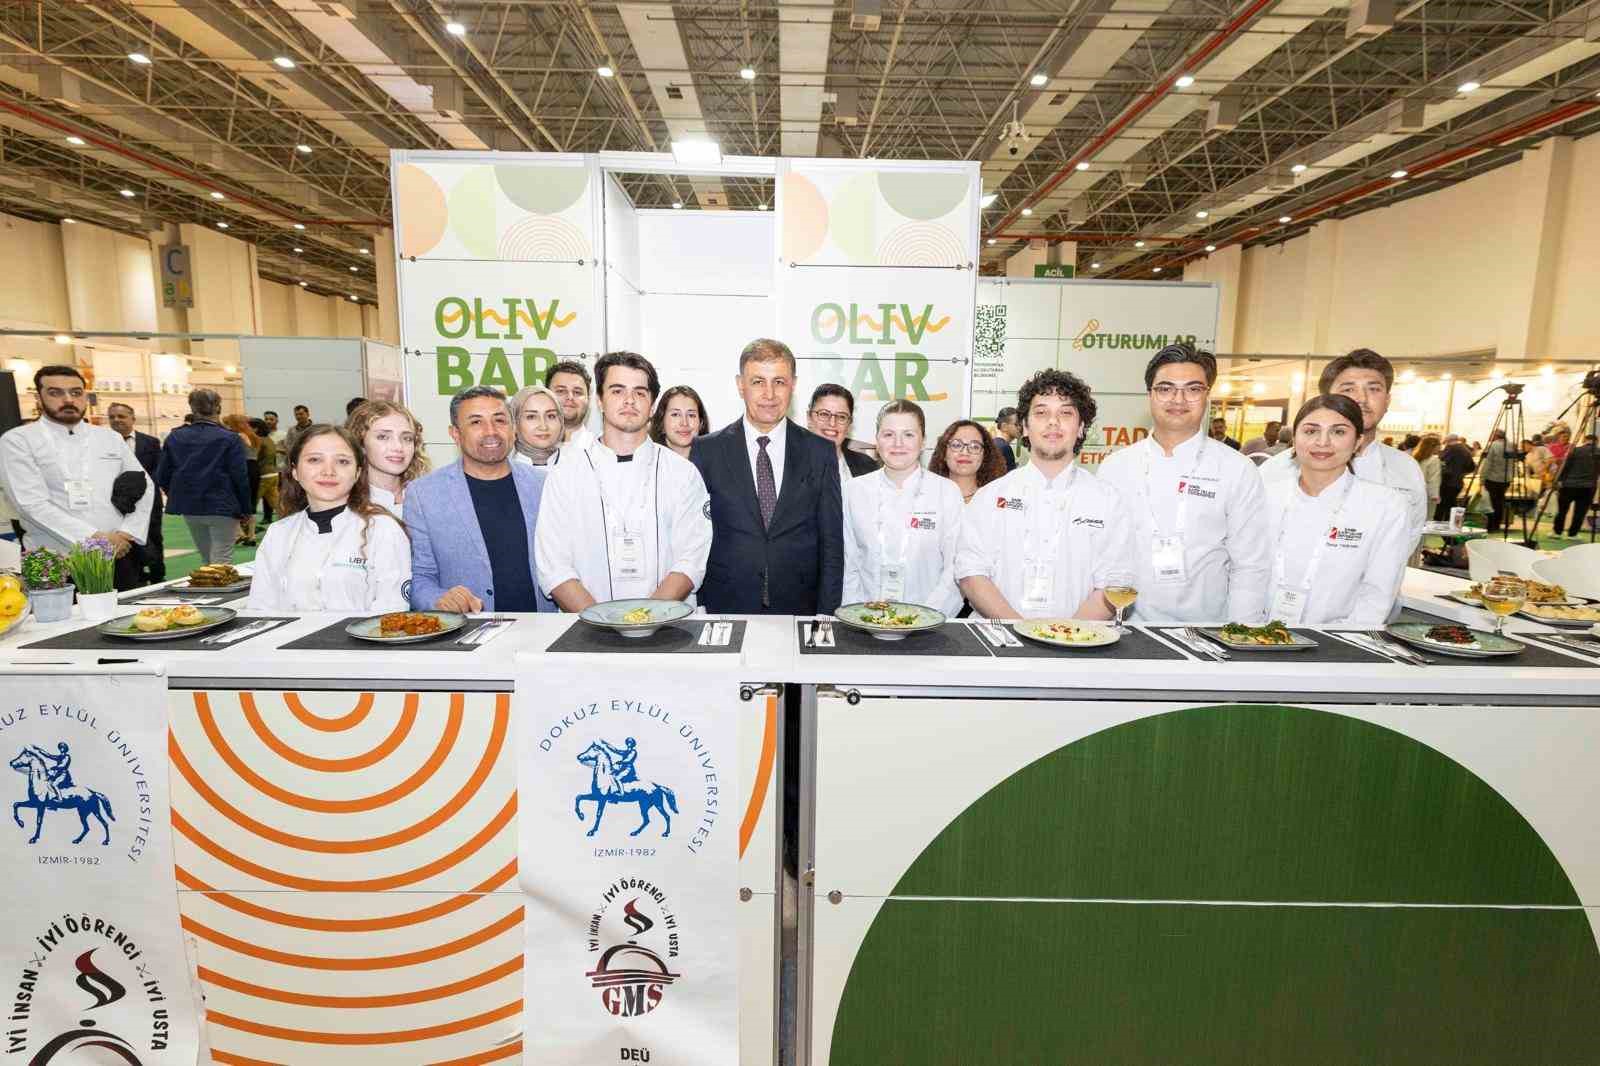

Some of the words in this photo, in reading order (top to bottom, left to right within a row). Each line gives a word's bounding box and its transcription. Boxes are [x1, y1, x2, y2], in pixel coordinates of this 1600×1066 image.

[435, 297, 560, 340] OLIV
[811, 302, 934, 346] OLIV
[436, 346, 558, 396] BAR
[0, 708, 27, 731] UZ
[39, 704, 97, 729] EYLÜL
[539, 703, 600, 752] DOKUZ
[611, 700, 671, 724] EYLÜL
[36, 922, 65, 953] İYİ
[63, 913, 143, 961] ÖĞRENCİ
[620, 877, 666, 904] ÖĞRENCİ
[668, 933, 679, 958] USTA
[8, 969, 39, 1020] İNSAN
[143, 980, 167, 1003] İYİ
[602, 984, 664, 1017] GMS
[6, 1028, 28, 1054] İYİ
[150, 1009, 169, 1051] USTA
[620, 1047, 650, 1063] DEÜ
